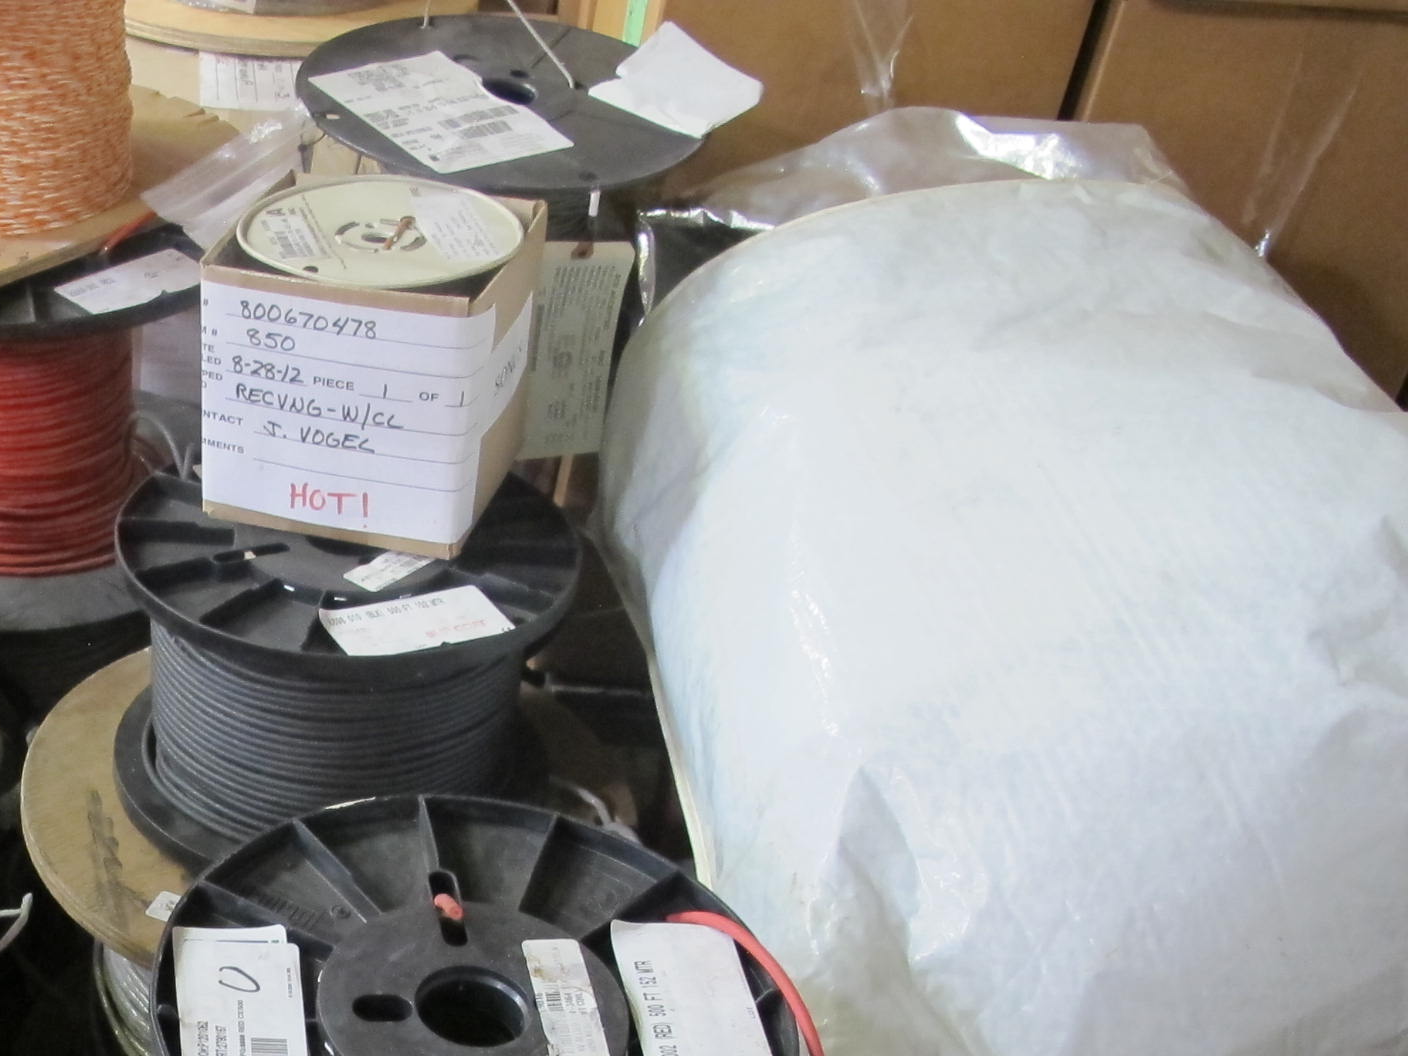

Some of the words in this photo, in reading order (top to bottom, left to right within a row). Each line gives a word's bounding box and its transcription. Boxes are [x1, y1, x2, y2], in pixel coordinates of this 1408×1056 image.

[240, 300, 378, 340] 800670478
[246, 328, 296, 352] 850
[231, 355, 305, 385] 8-28-12
[312, 375, 355, 392] PIECE
[418, 391, 440, 402] OF
[300, 426, 376, 454] VOGEL
